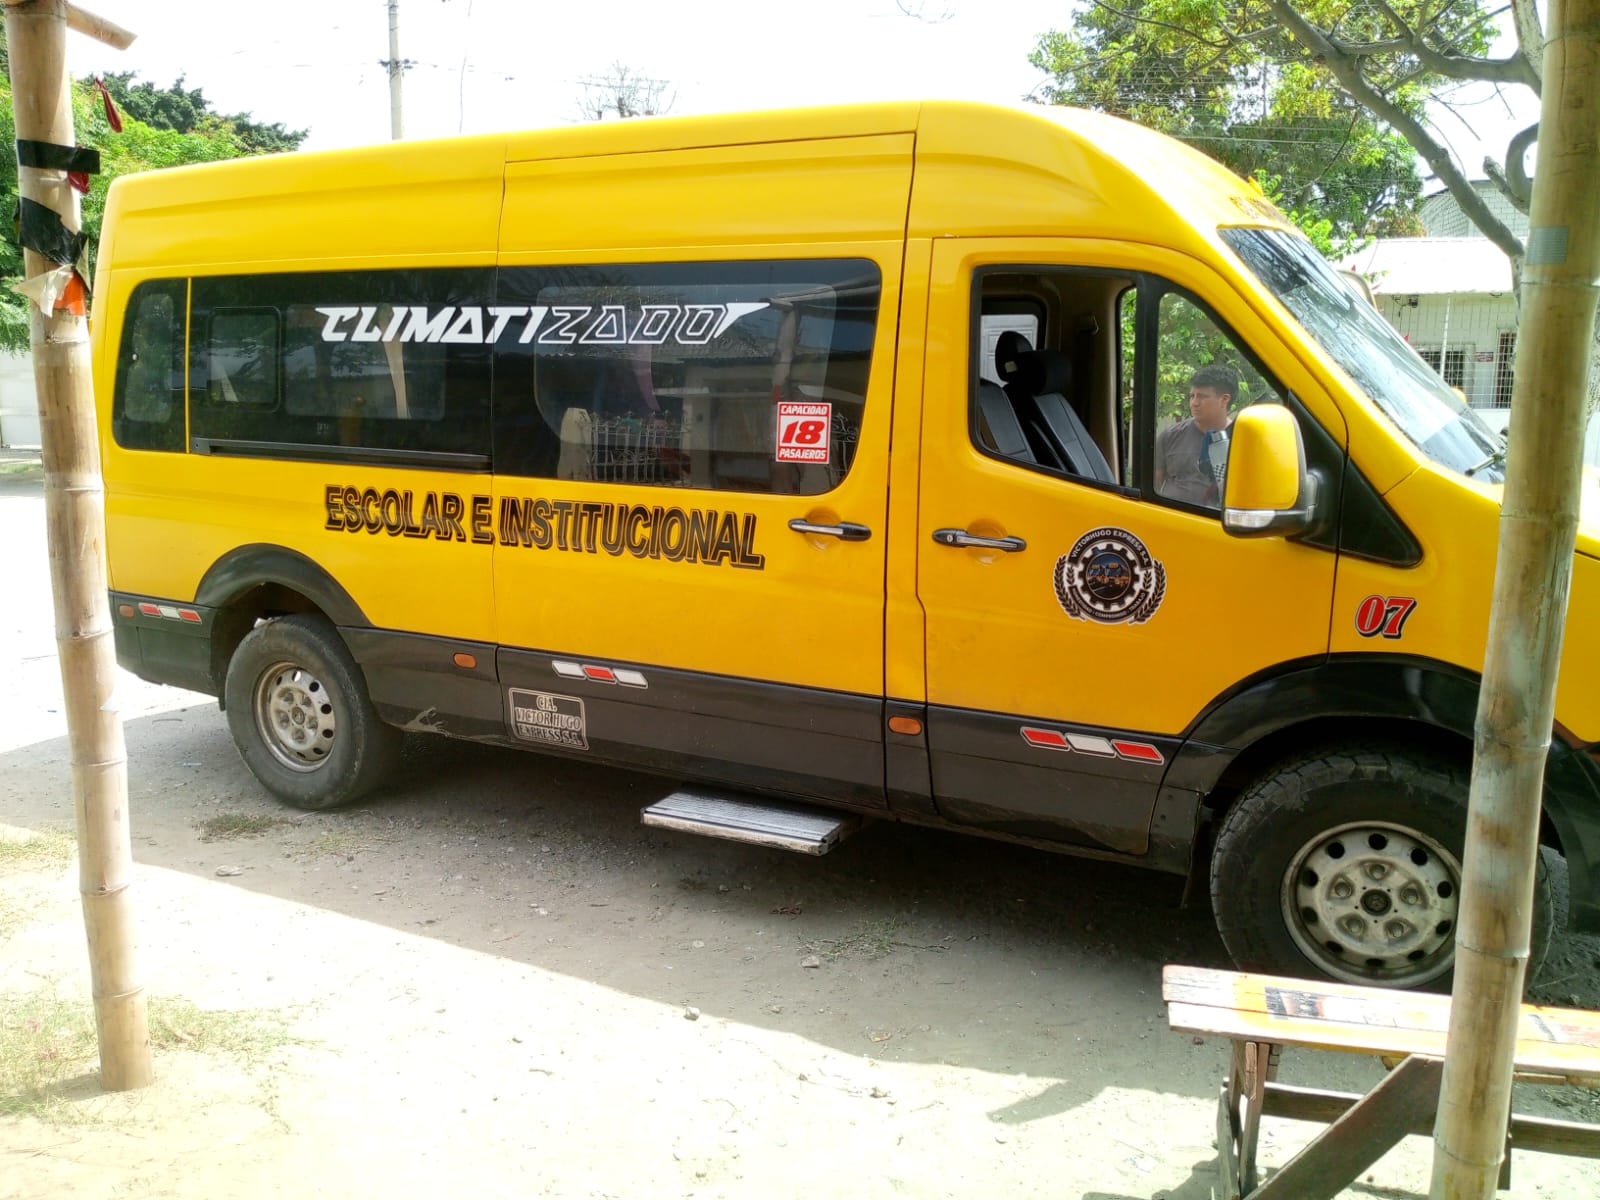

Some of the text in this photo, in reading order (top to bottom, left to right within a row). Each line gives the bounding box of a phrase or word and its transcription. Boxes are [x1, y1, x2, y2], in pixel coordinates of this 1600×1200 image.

[315, 302, 770, 344] CLIMATIZADO
[781, 405, 828, 415] CAPACIDAD
[782, 420, 825, 444] 18
[779, 447, 827, 459] PASAJEROS
[324, 484, 766, 570] ESCOLAR E INSTITUCIONAL
[1070, 529, 1112, 558] VICTORHUGO
[1112, 529, 1143, 551] EXPRESS
[1355, 594, 1417, 640] 07
[536, 695, 558, 712] CIA.
[515, 707, 582, 731] VICTOR HUGO
[517, 723, 561, 741] EXPRESS
